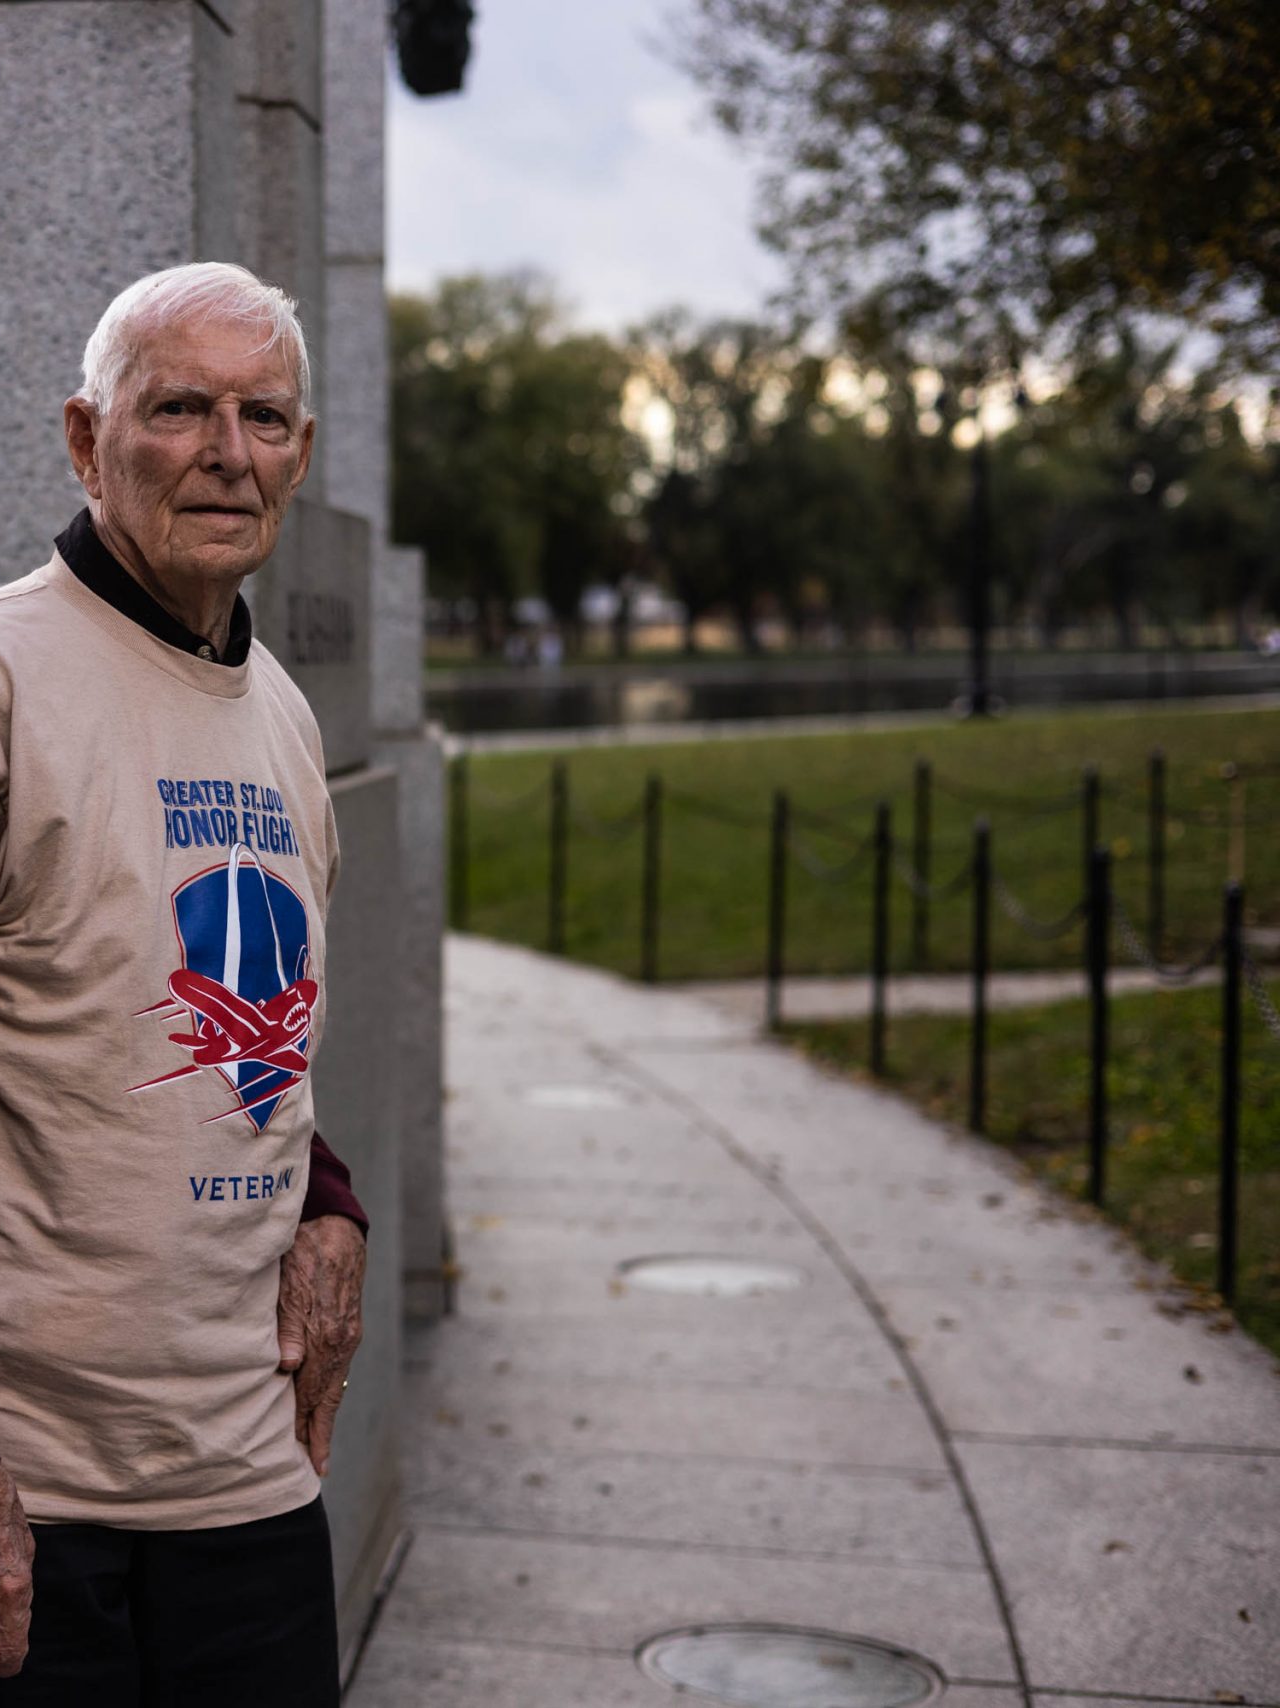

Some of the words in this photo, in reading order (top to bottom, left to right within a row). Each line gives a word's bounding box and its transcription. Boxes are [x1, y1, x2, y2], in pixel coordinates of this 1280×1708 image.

[157, 779, 236, 807] GREATER
[260, 786, 286, 814] LOU
[164, 808, 238, 848] HONOR
